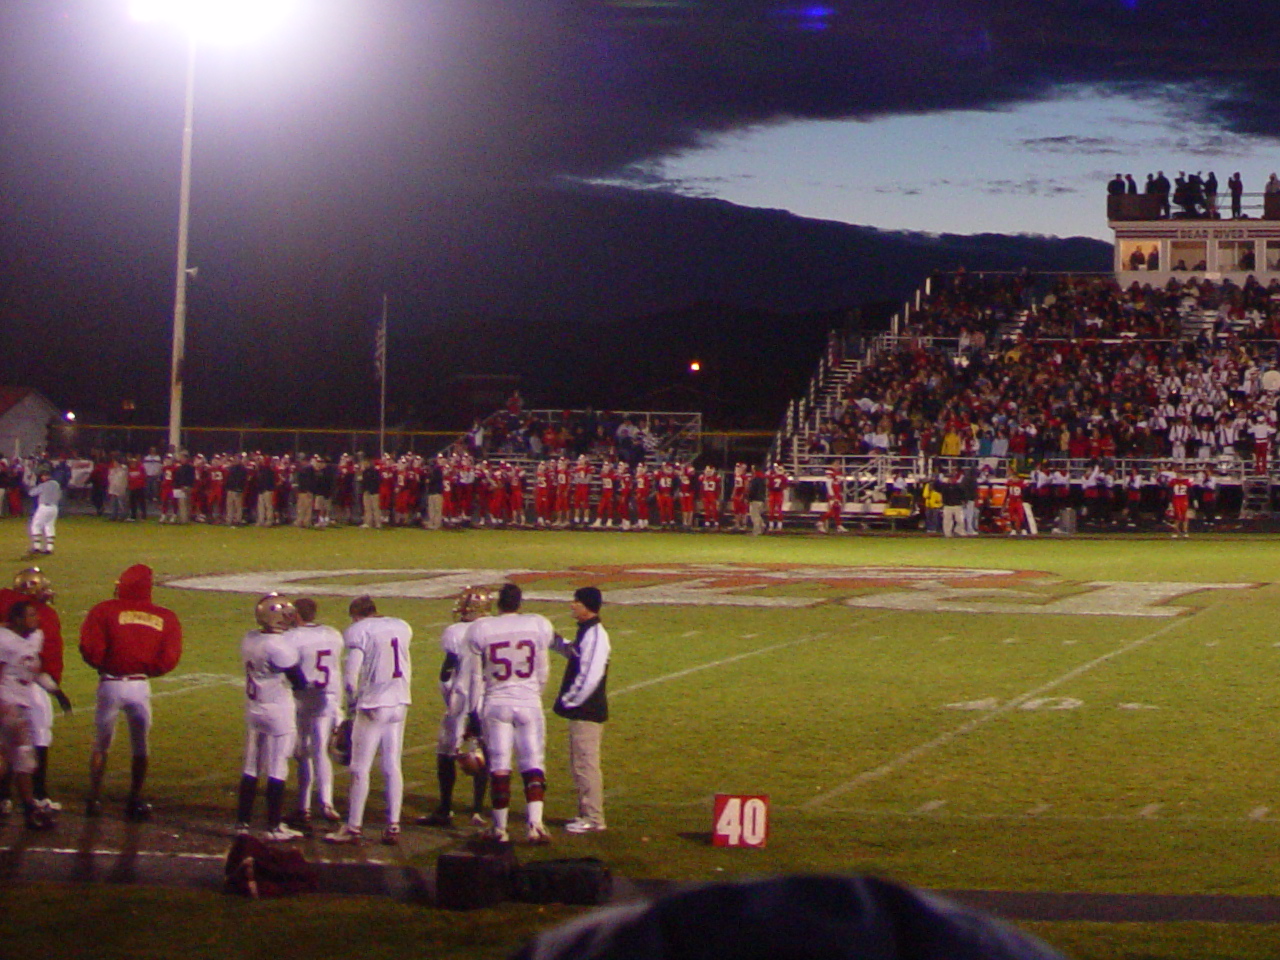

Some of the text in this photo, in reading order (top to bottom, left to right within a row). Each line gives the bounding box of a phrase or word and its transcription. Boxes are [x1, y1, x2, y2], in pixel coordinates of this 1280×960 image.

[316, 649, 331, 689] 5
[391, 637, 403, 679] 1
[490, 639, 536, 681] 53
[716, 797, 767, 845] 40
